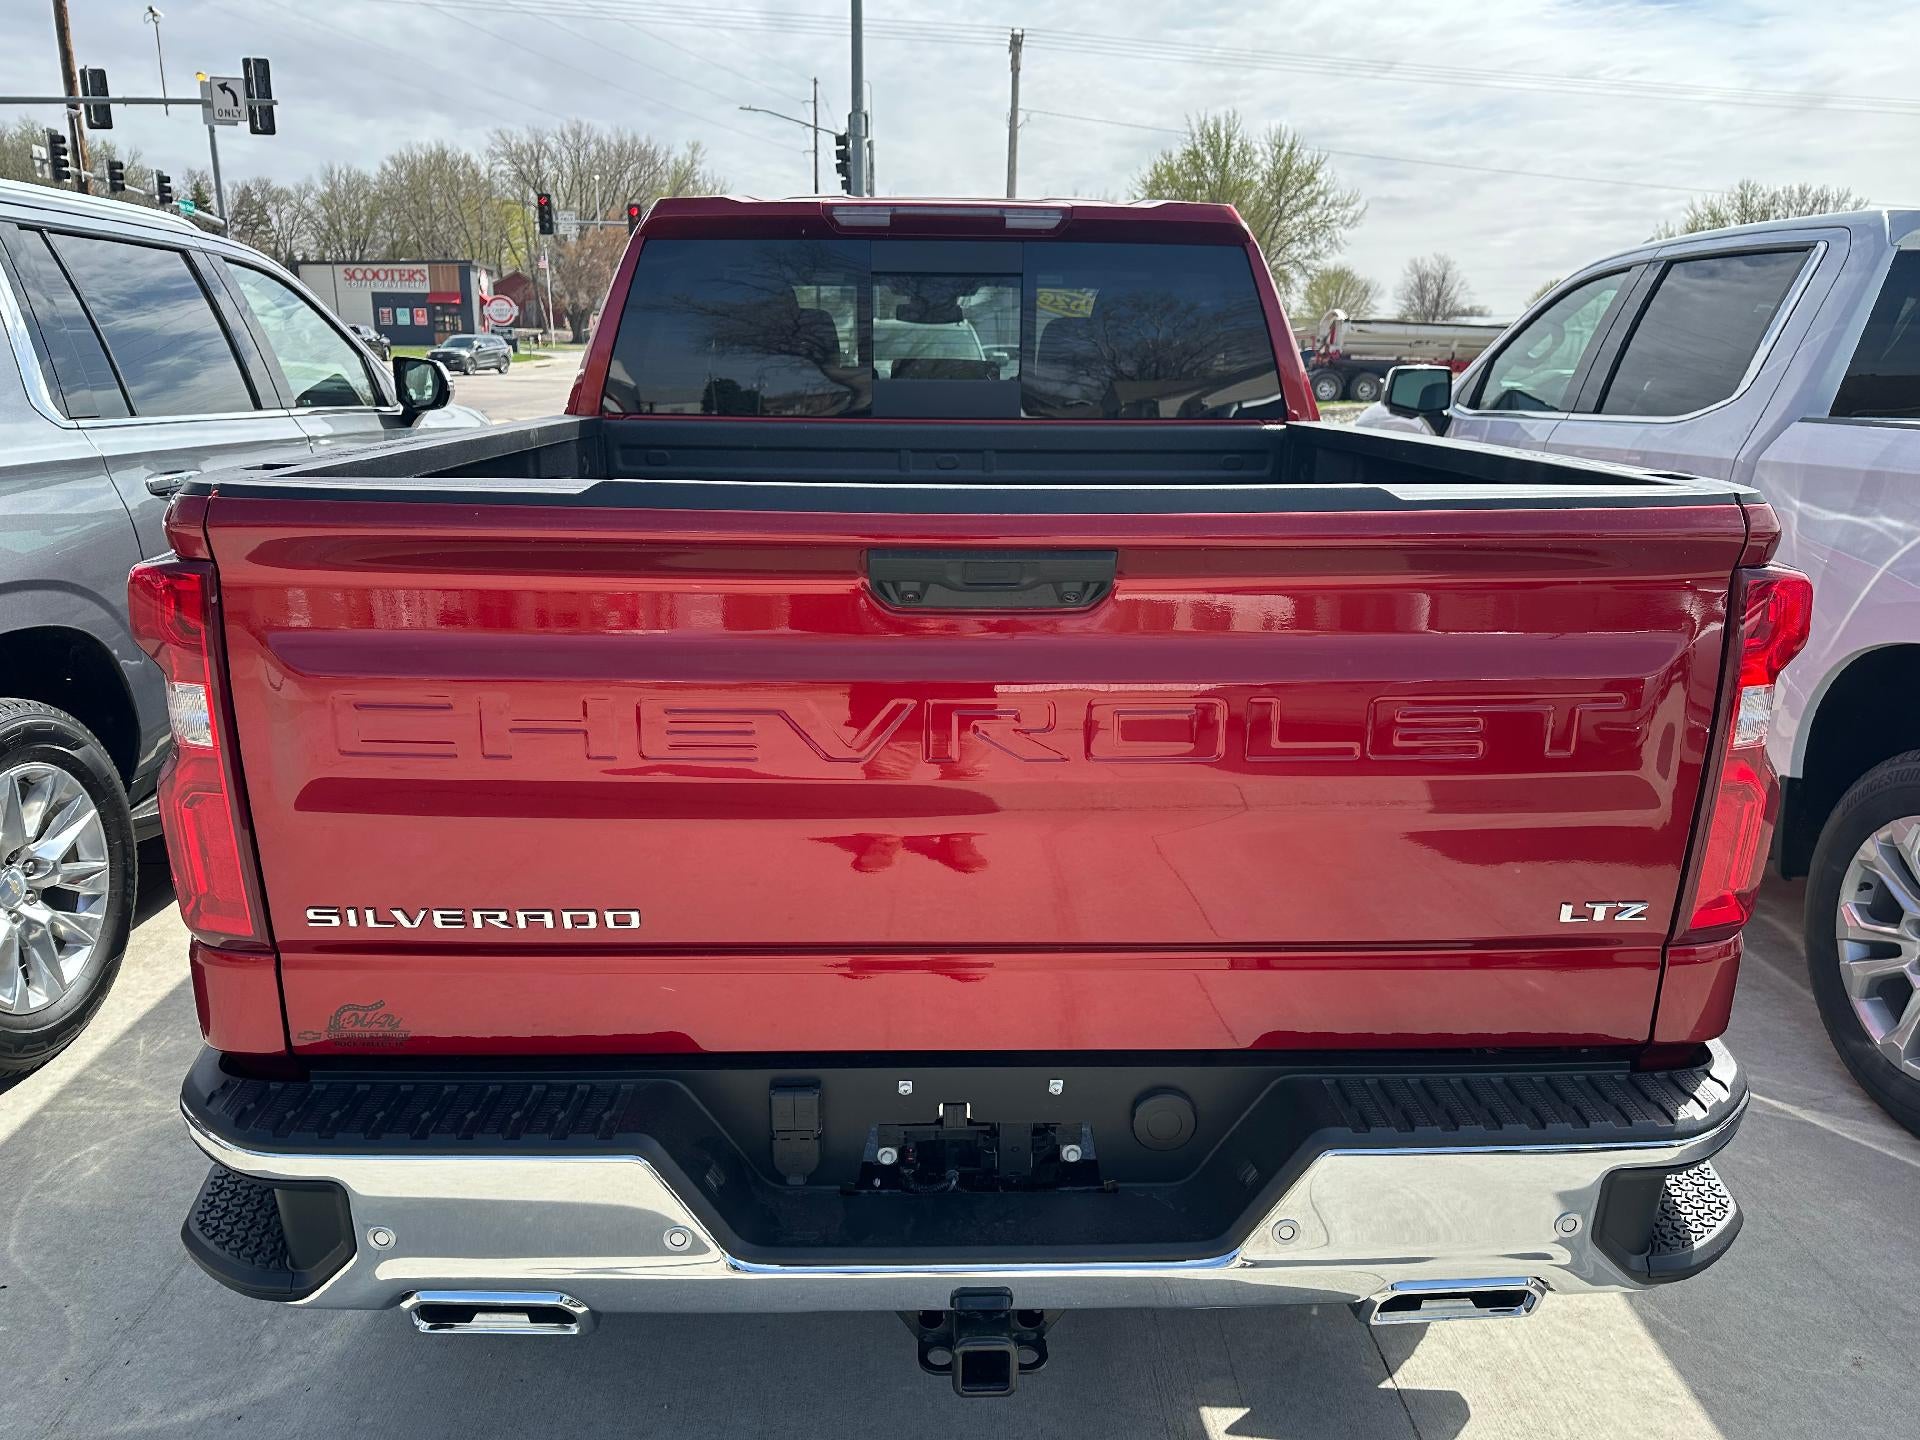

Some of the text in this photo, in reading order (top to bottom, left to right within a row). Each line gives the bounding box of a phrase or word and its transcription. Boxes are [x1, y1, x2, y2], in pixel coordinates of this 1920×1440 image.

[217, 108, 242, 118] ONLY
[344, 267, 427, 282] SCOOTER'S
[332, 692, 1626, 763] CHEVROLET
[305, 905, 642, 930] SILVERADO
[1559, 901, 1649, 922] LTZ
